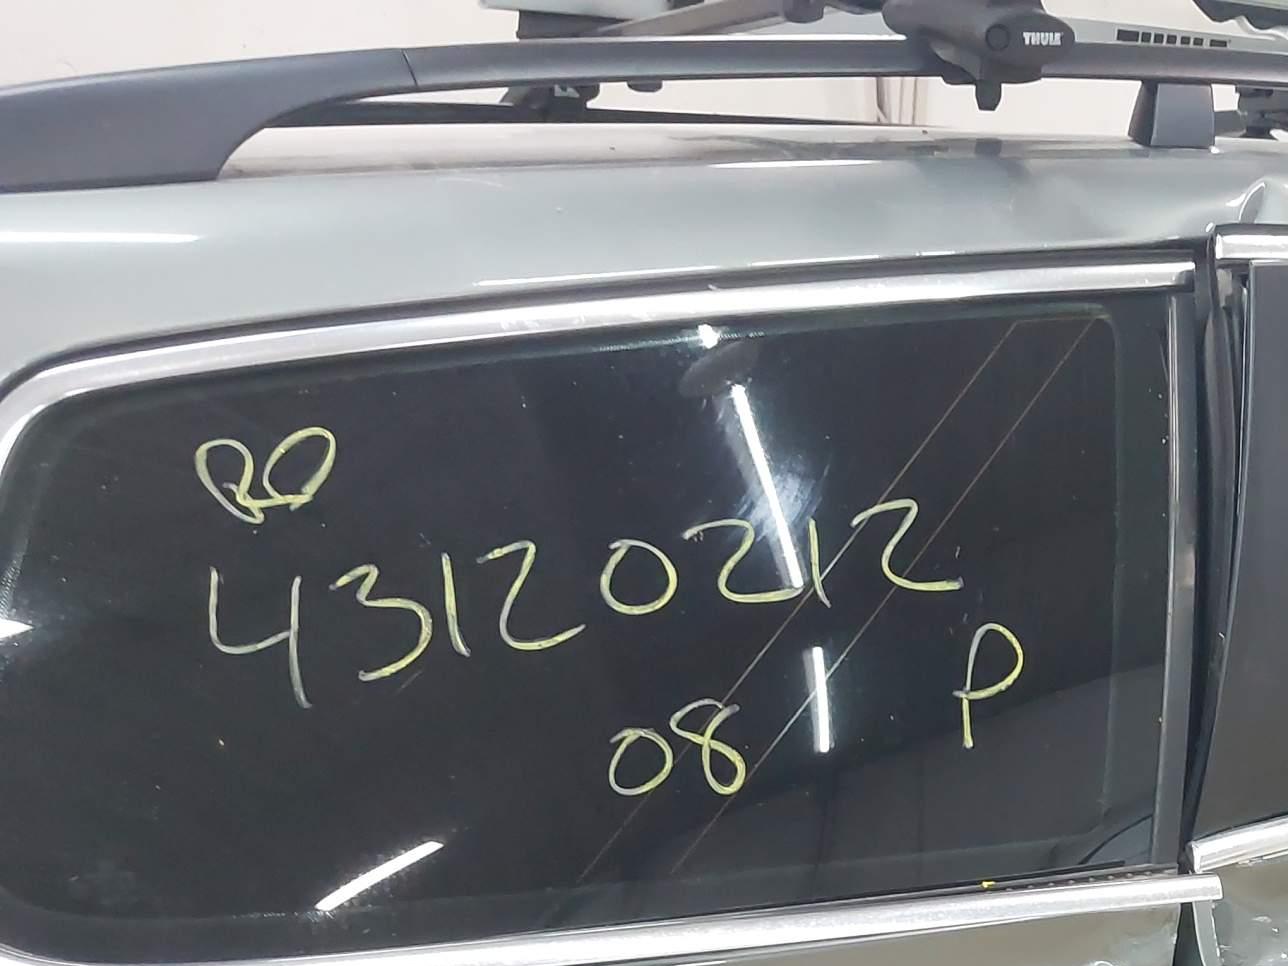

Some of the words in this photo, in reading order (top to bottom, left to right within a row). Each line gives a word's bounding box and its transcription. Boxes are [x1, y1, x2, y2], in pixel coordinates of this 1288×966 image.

[1022, 31, 1062, 46] THULE
[953, 623, 1024, 749] P
[608, 698, 747, 796] 08
